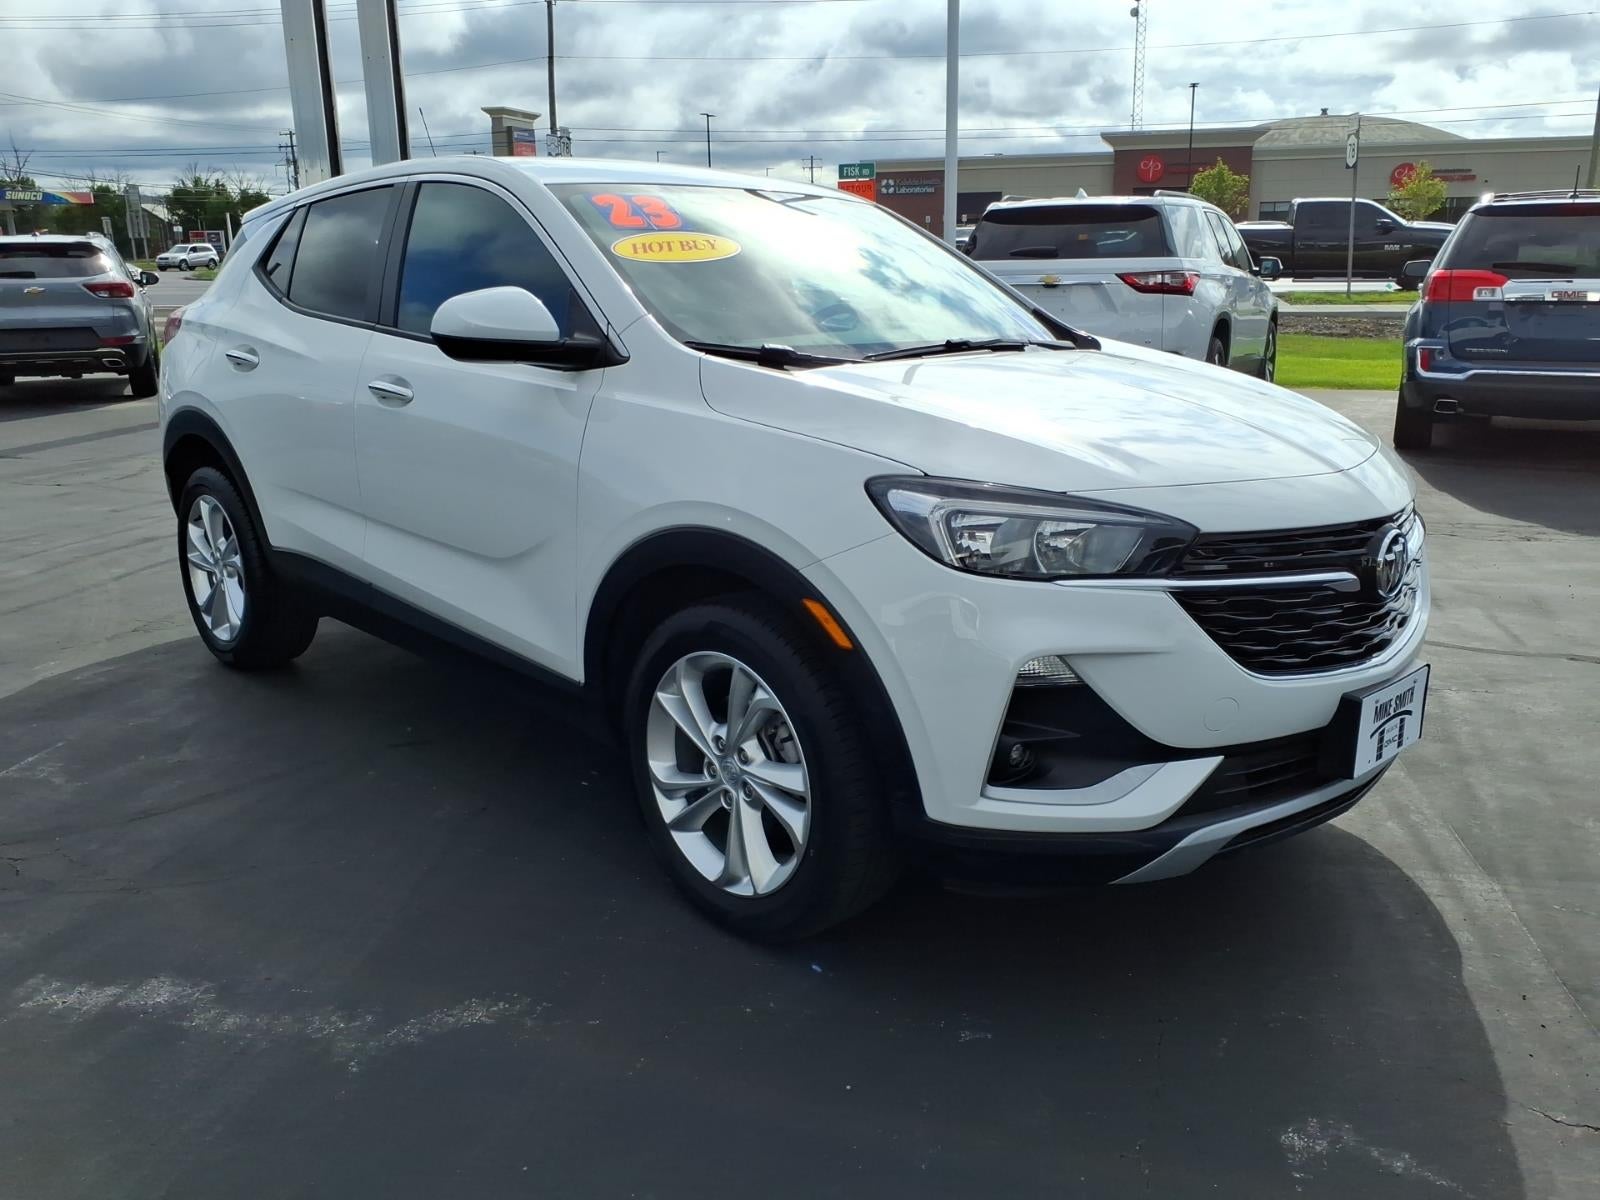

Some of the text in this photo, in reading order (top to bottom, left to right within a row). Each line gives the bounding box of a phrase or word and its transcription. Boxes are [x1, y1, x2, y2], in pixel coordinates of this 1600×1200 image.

[843, 166, 860, 177] FISK
[5, 190, 43, 201] SUNOCO
[591, 192, 683, 230] 23
[631, 239, 717, 255] HOT BUY
[1551, 290, 1588, 299] GMC
[1373, 685, 1415, 724] MIKE SMITH
